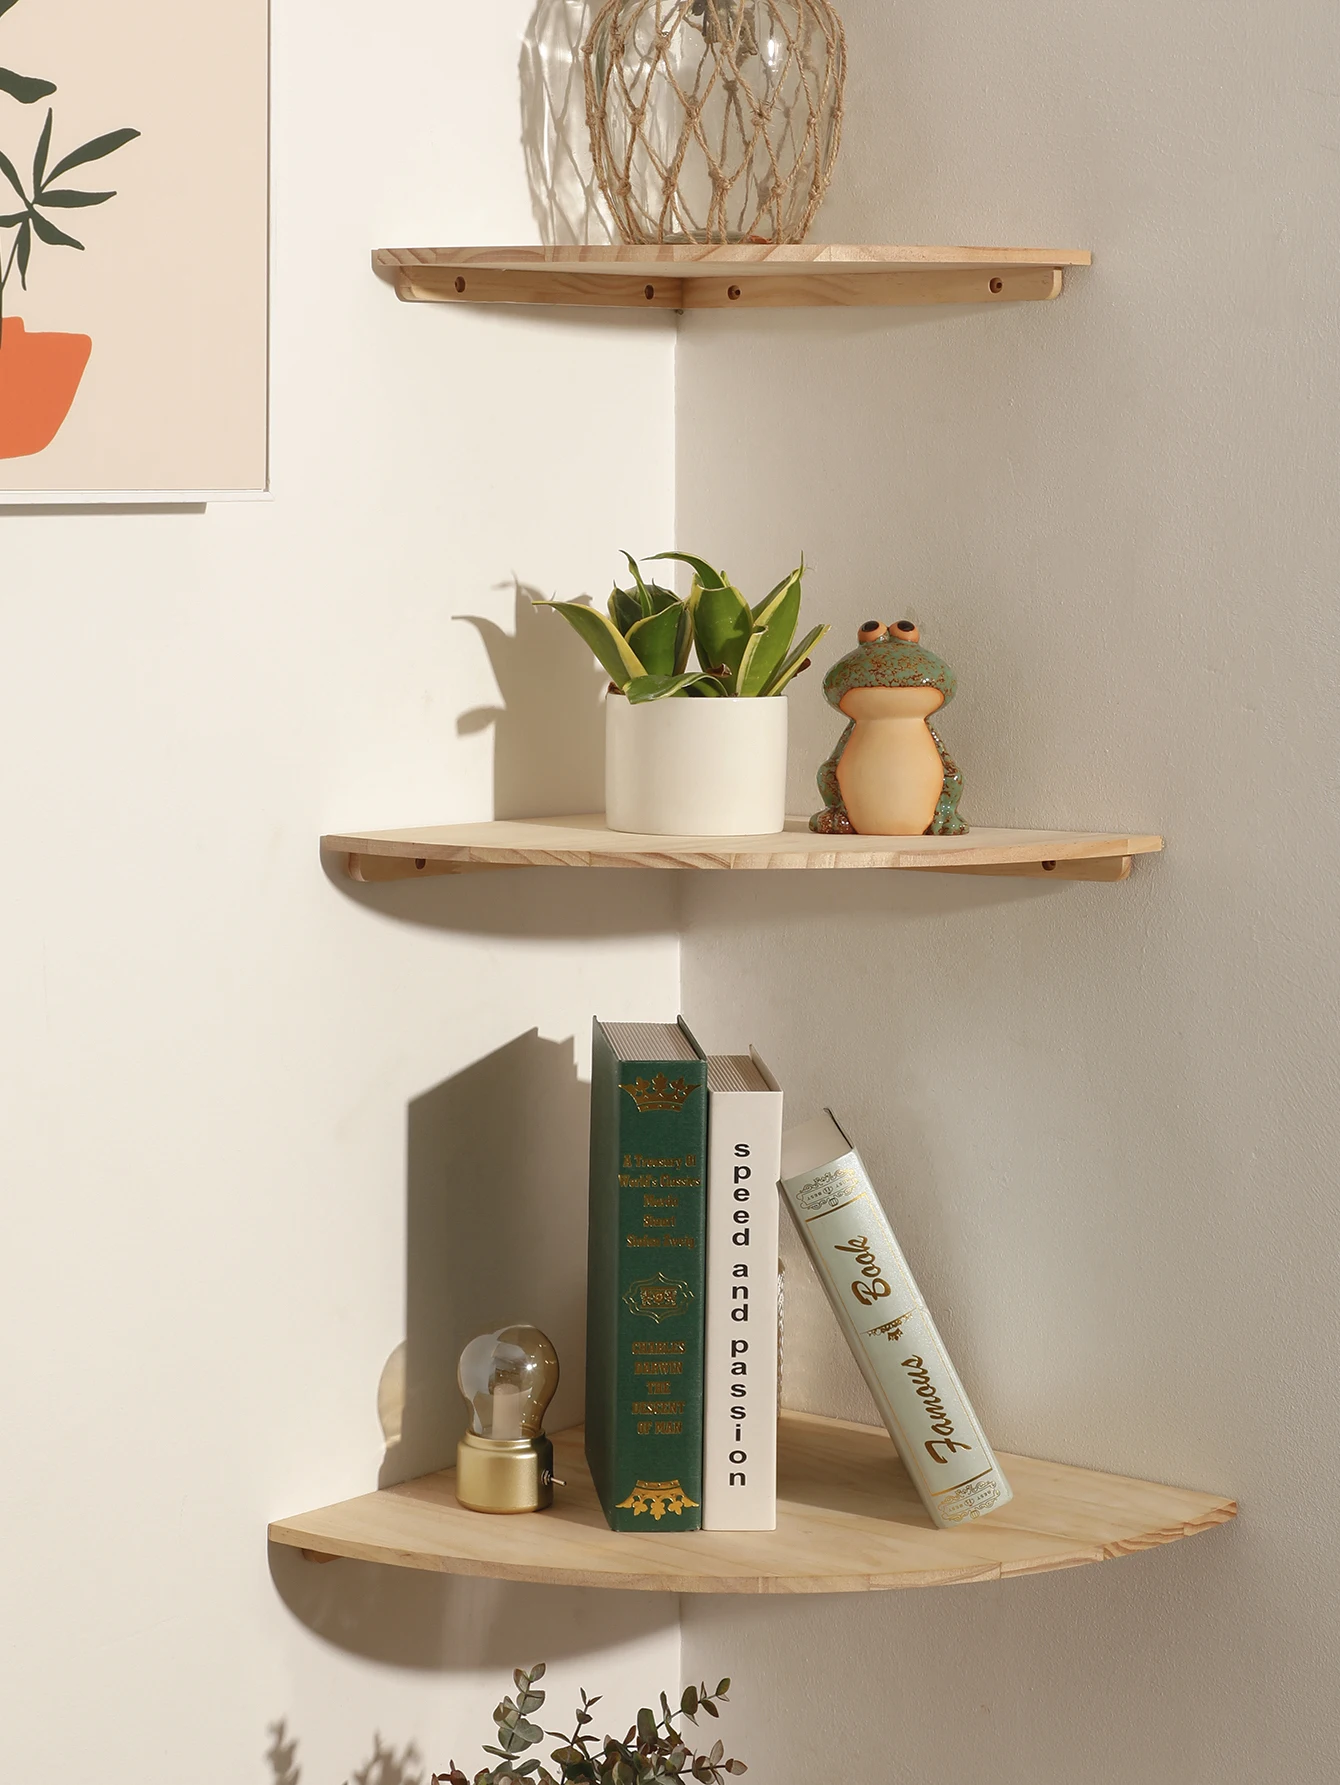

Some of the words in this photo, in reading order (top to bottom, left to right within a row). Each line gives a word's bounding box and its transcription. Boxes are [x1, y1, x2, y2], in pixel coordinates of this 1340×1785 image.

[623, 1154, 632, 1167] A
[660, 1174, 701, 1188] Classics
[733, 1144, 751, 1245] speed
[834, 1235, 891, 1306] Book
[731, 1264, 748, 1321] and
[632, 1342, 686, 1355] CHARLES
[634, 1362, 683, 1375] DARWIN
[645, 1382, 671, 1394] THE
[631, 1402, 685, 1415] DESCENT
[729, 1340, 748, 1485] passion
[901, 1354, 972, 1464] Famous
[637, 1421, 653, 1435] OF
[654, 1421, 683, 1435] MAN
